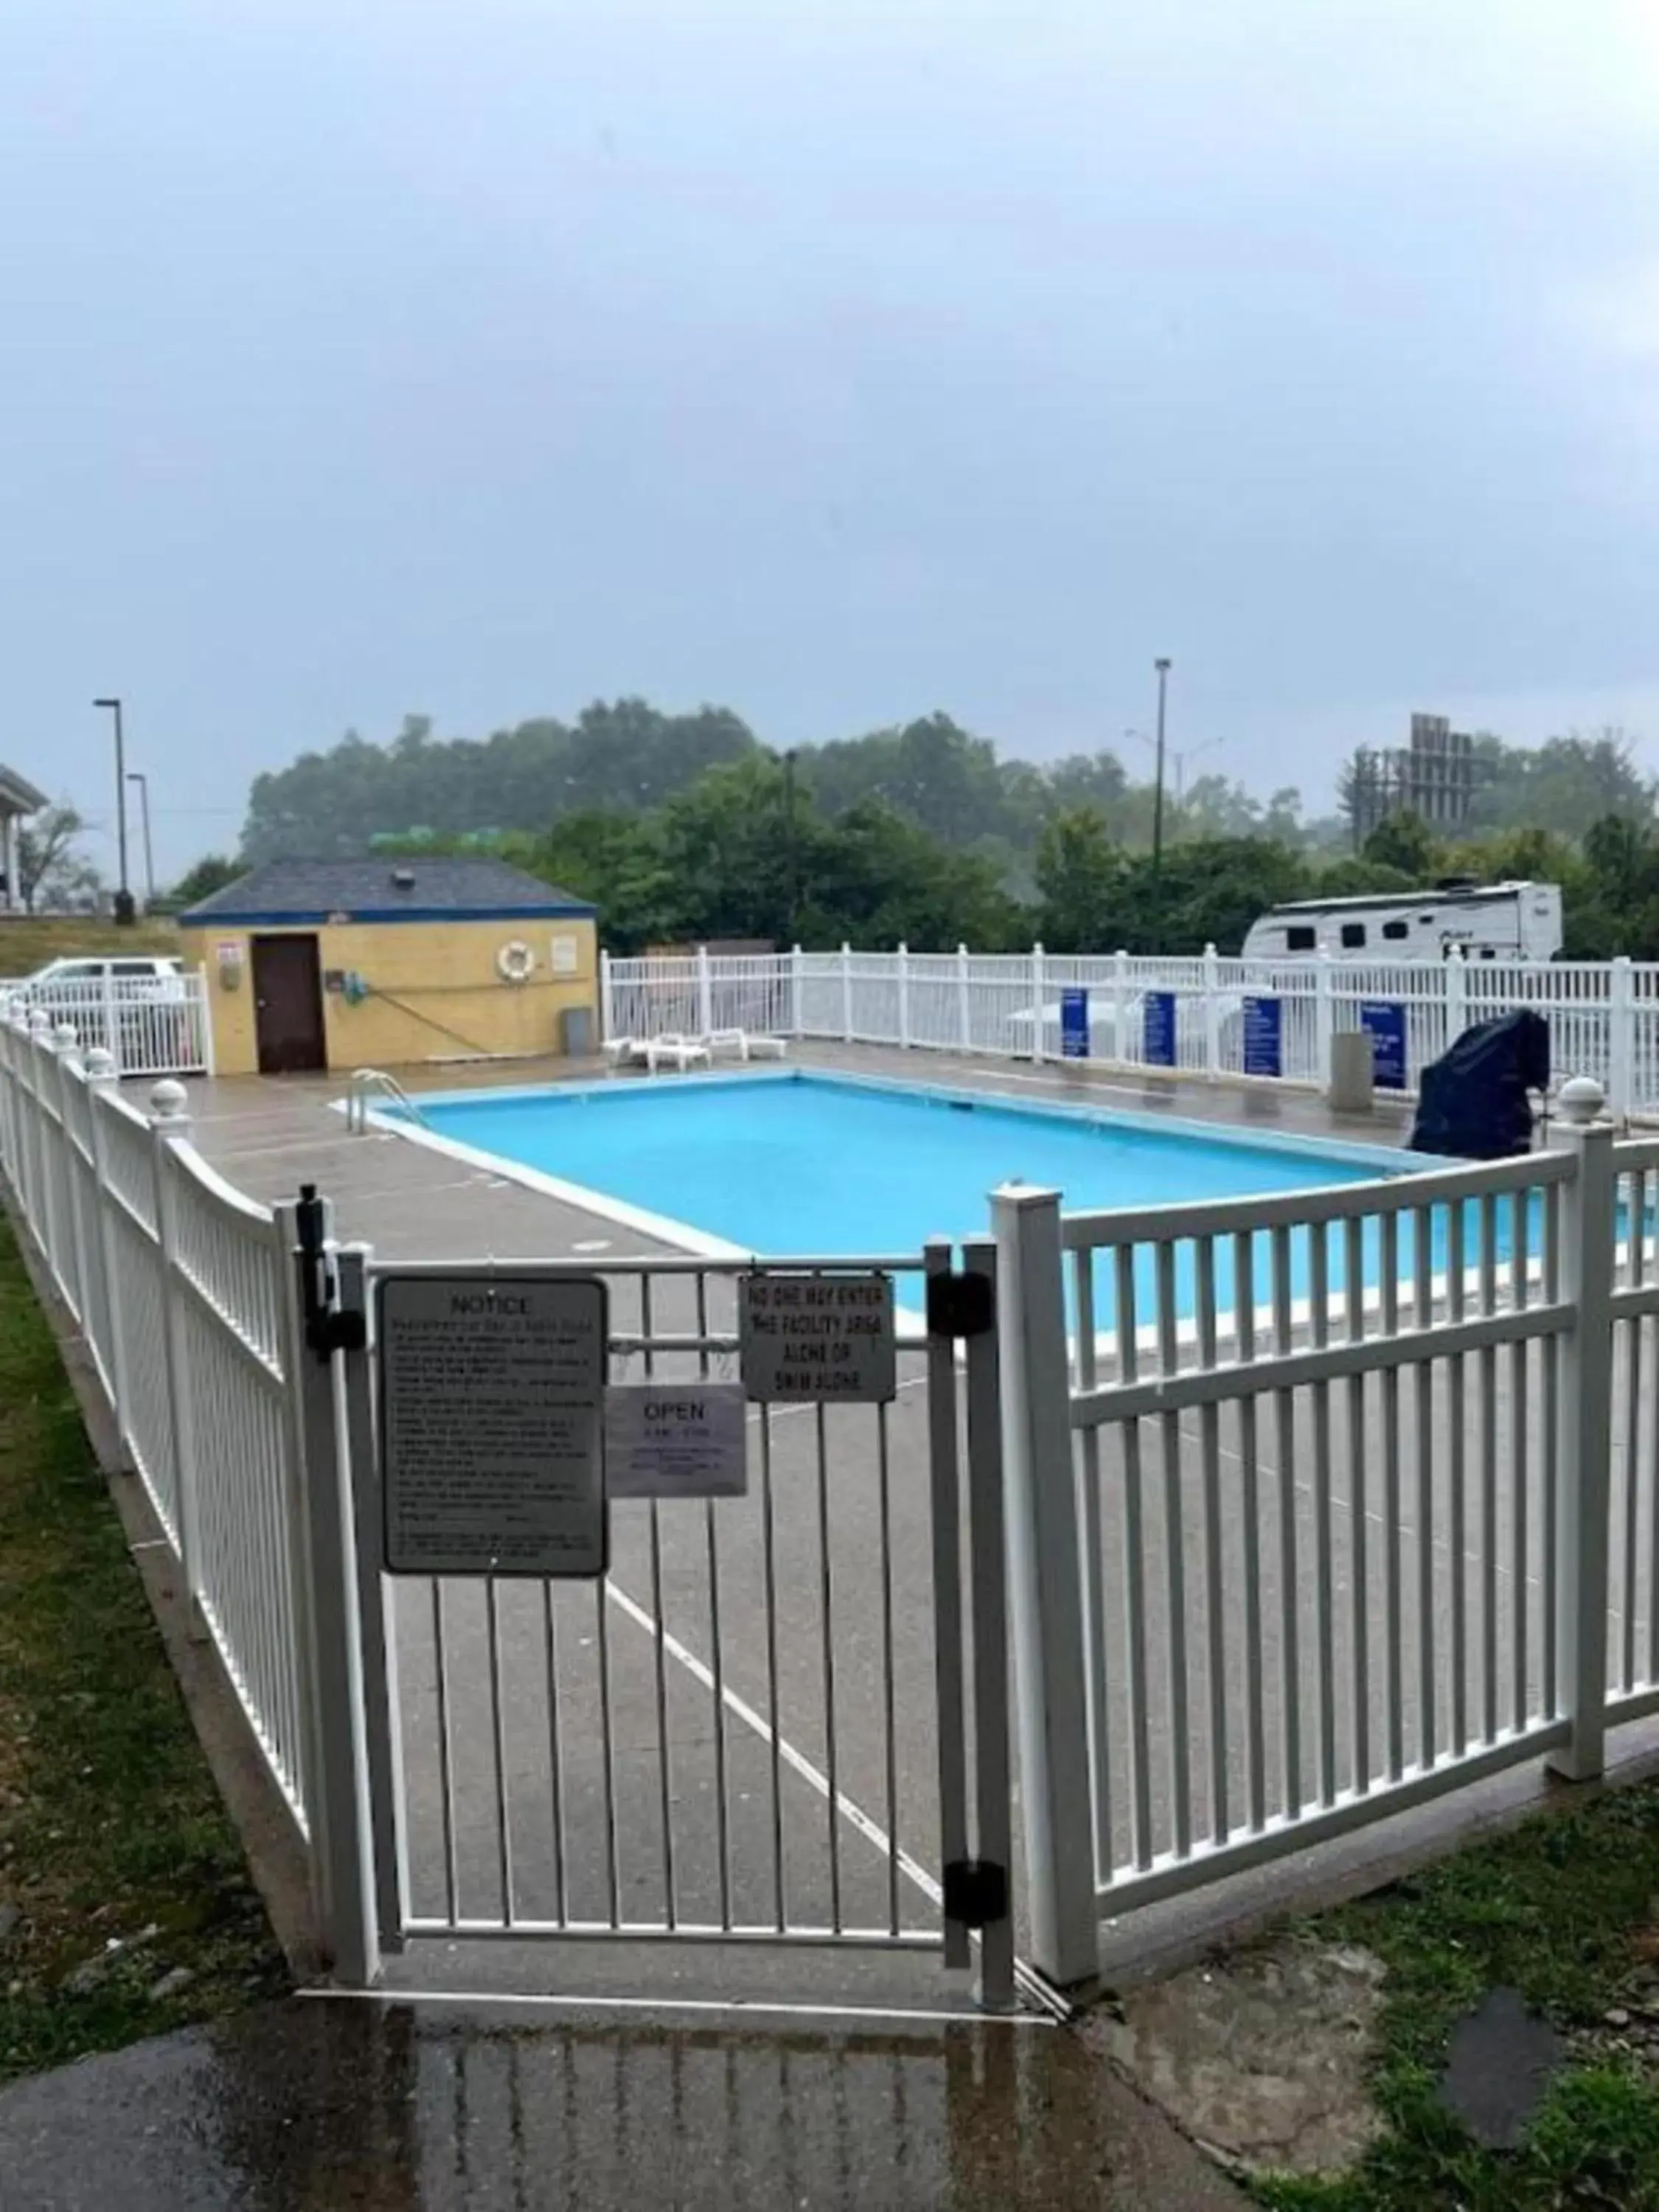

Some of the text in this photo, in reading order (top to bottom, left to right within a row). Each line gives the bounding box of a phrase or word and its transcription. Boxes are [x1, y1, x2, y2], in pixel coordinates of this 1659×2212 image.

[451, 1295, 531, 1315] NOTICE
[838, 1285, 883, 1306] ENTER
[751, 1313, 883, 1336] THE FACILITY AREA
[783, 1342, 826, 1363] ALONE
[644, 1402, 705, 1421] OPEN
